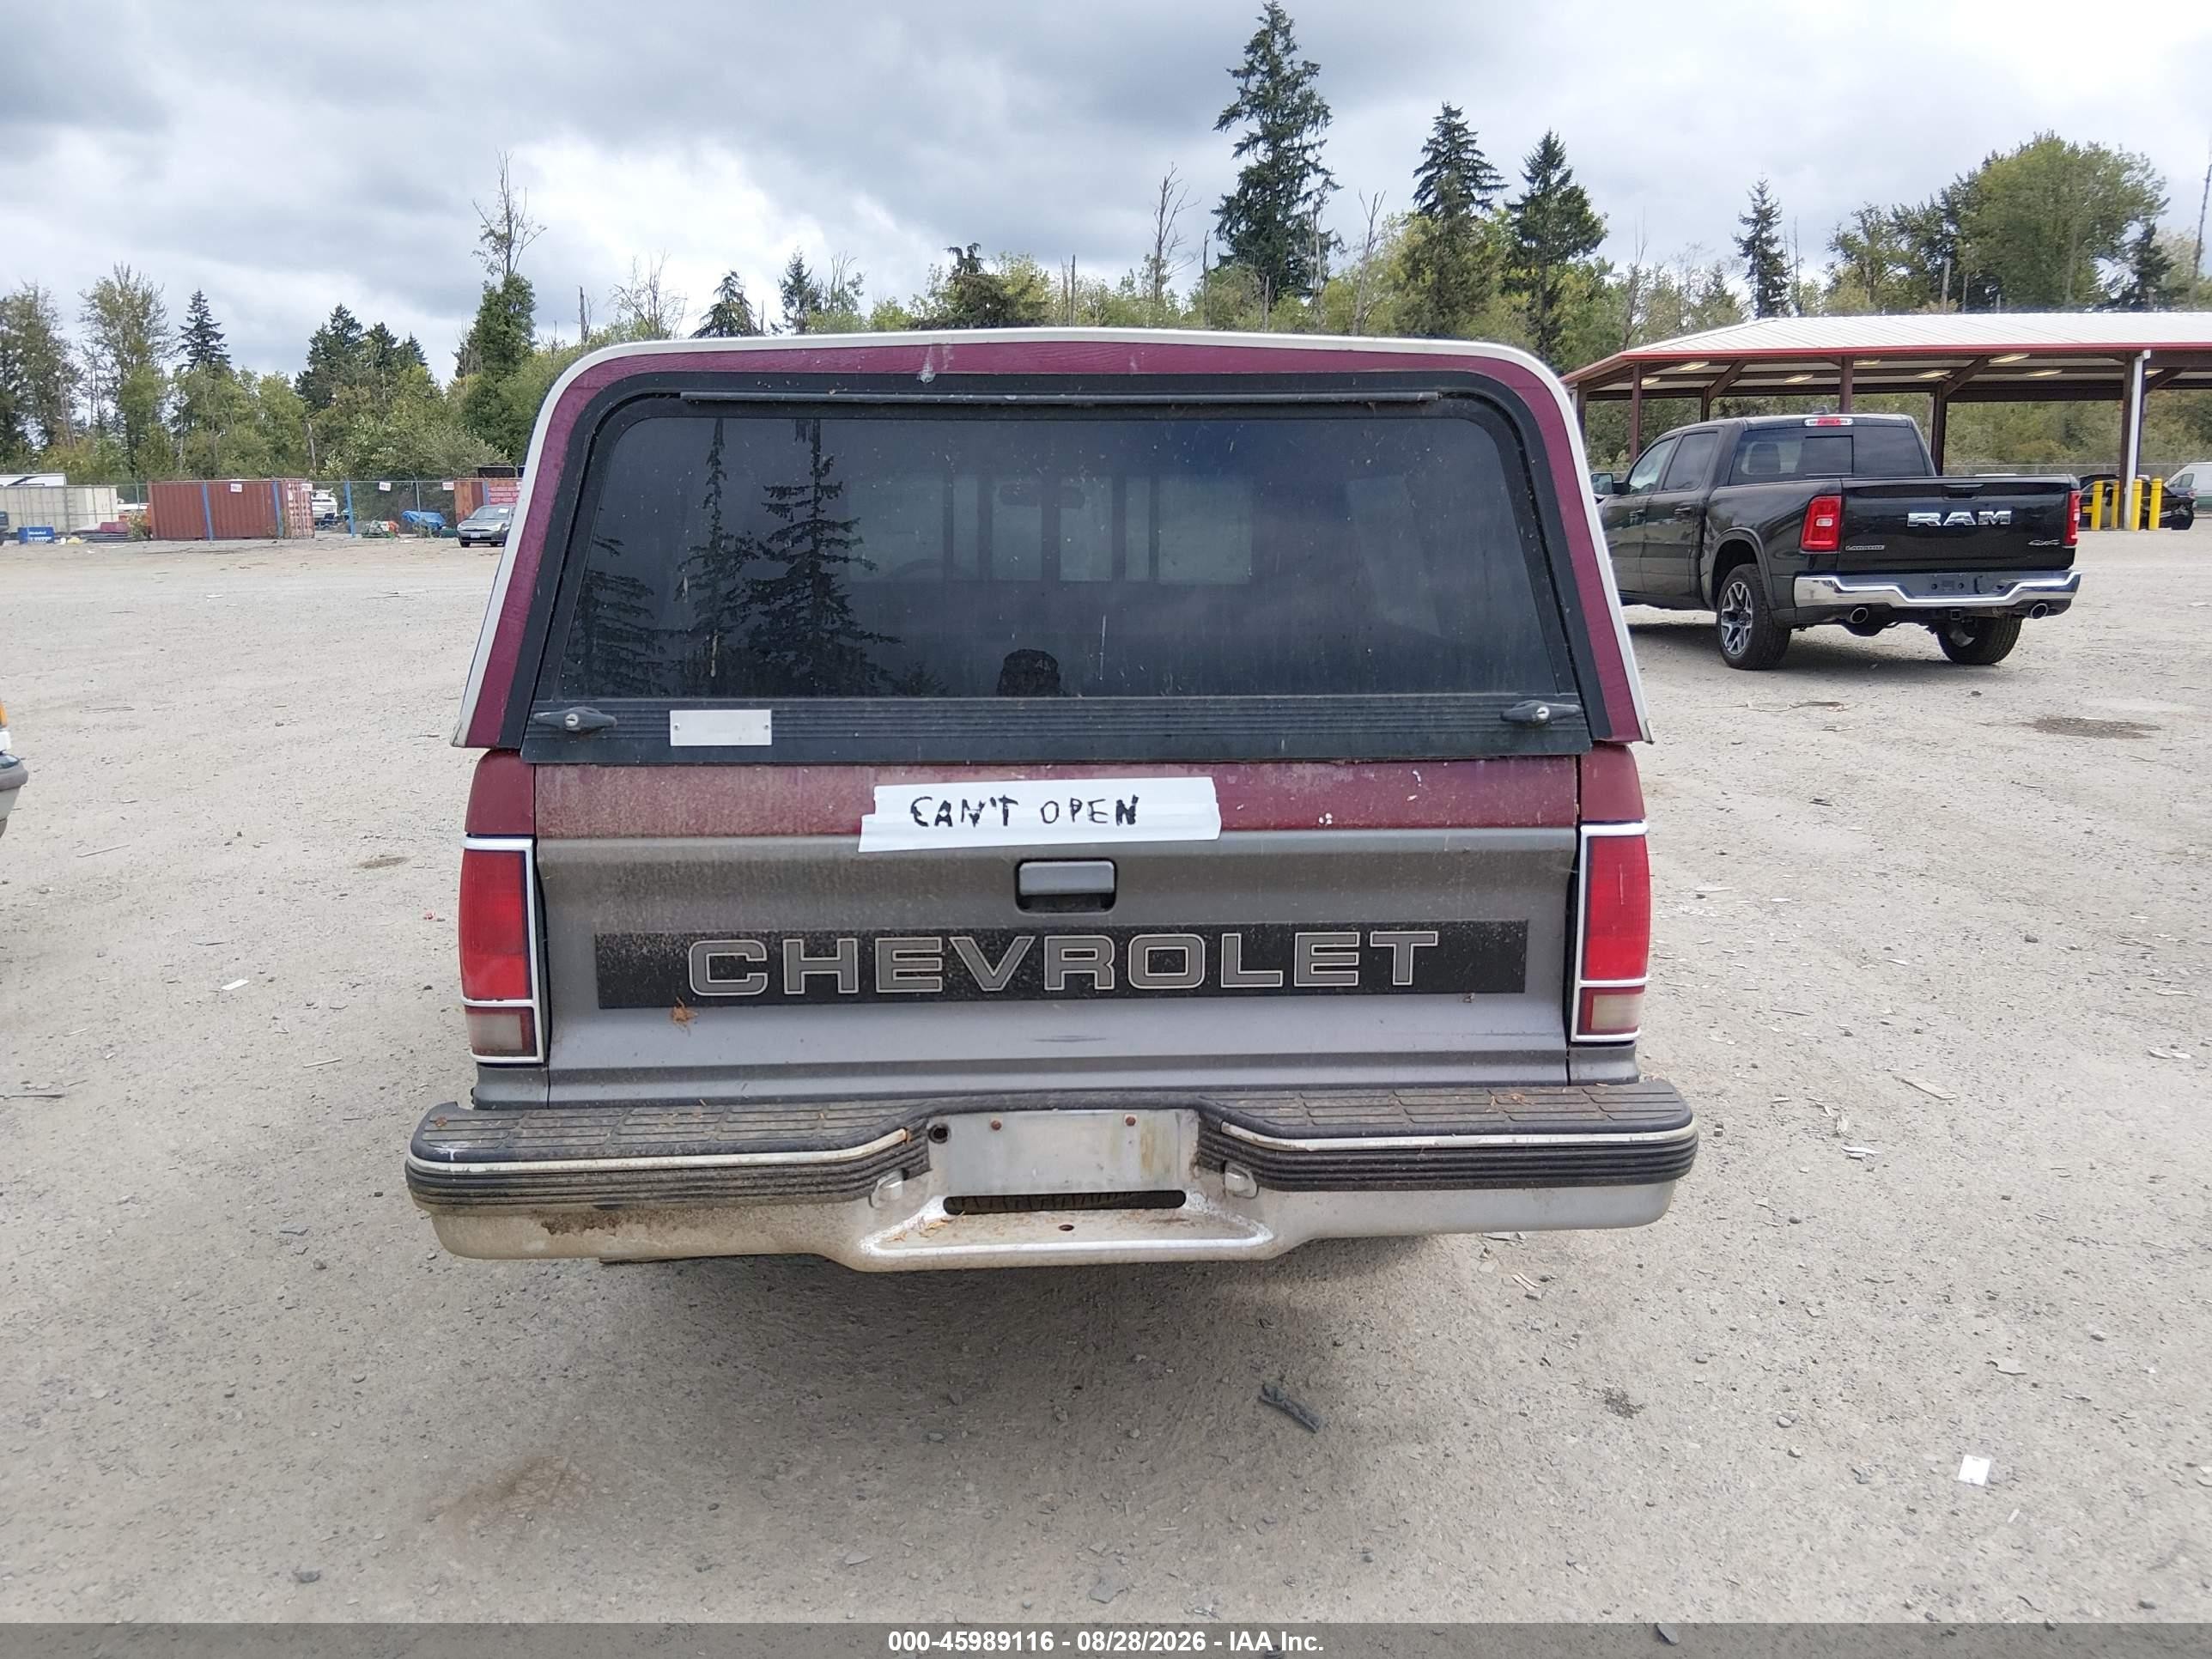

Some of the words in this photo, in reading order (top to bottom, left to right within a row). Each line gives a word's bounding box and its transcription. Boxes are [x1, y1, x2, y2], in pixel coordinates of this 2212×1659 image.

[1906, 510, 2012, 527] RAM
[910, 795, 1018, 827] CAN'T
[1040, 794, 1139, 826] OPEN
[688, 930, 1439, 997] CHEVROLET
